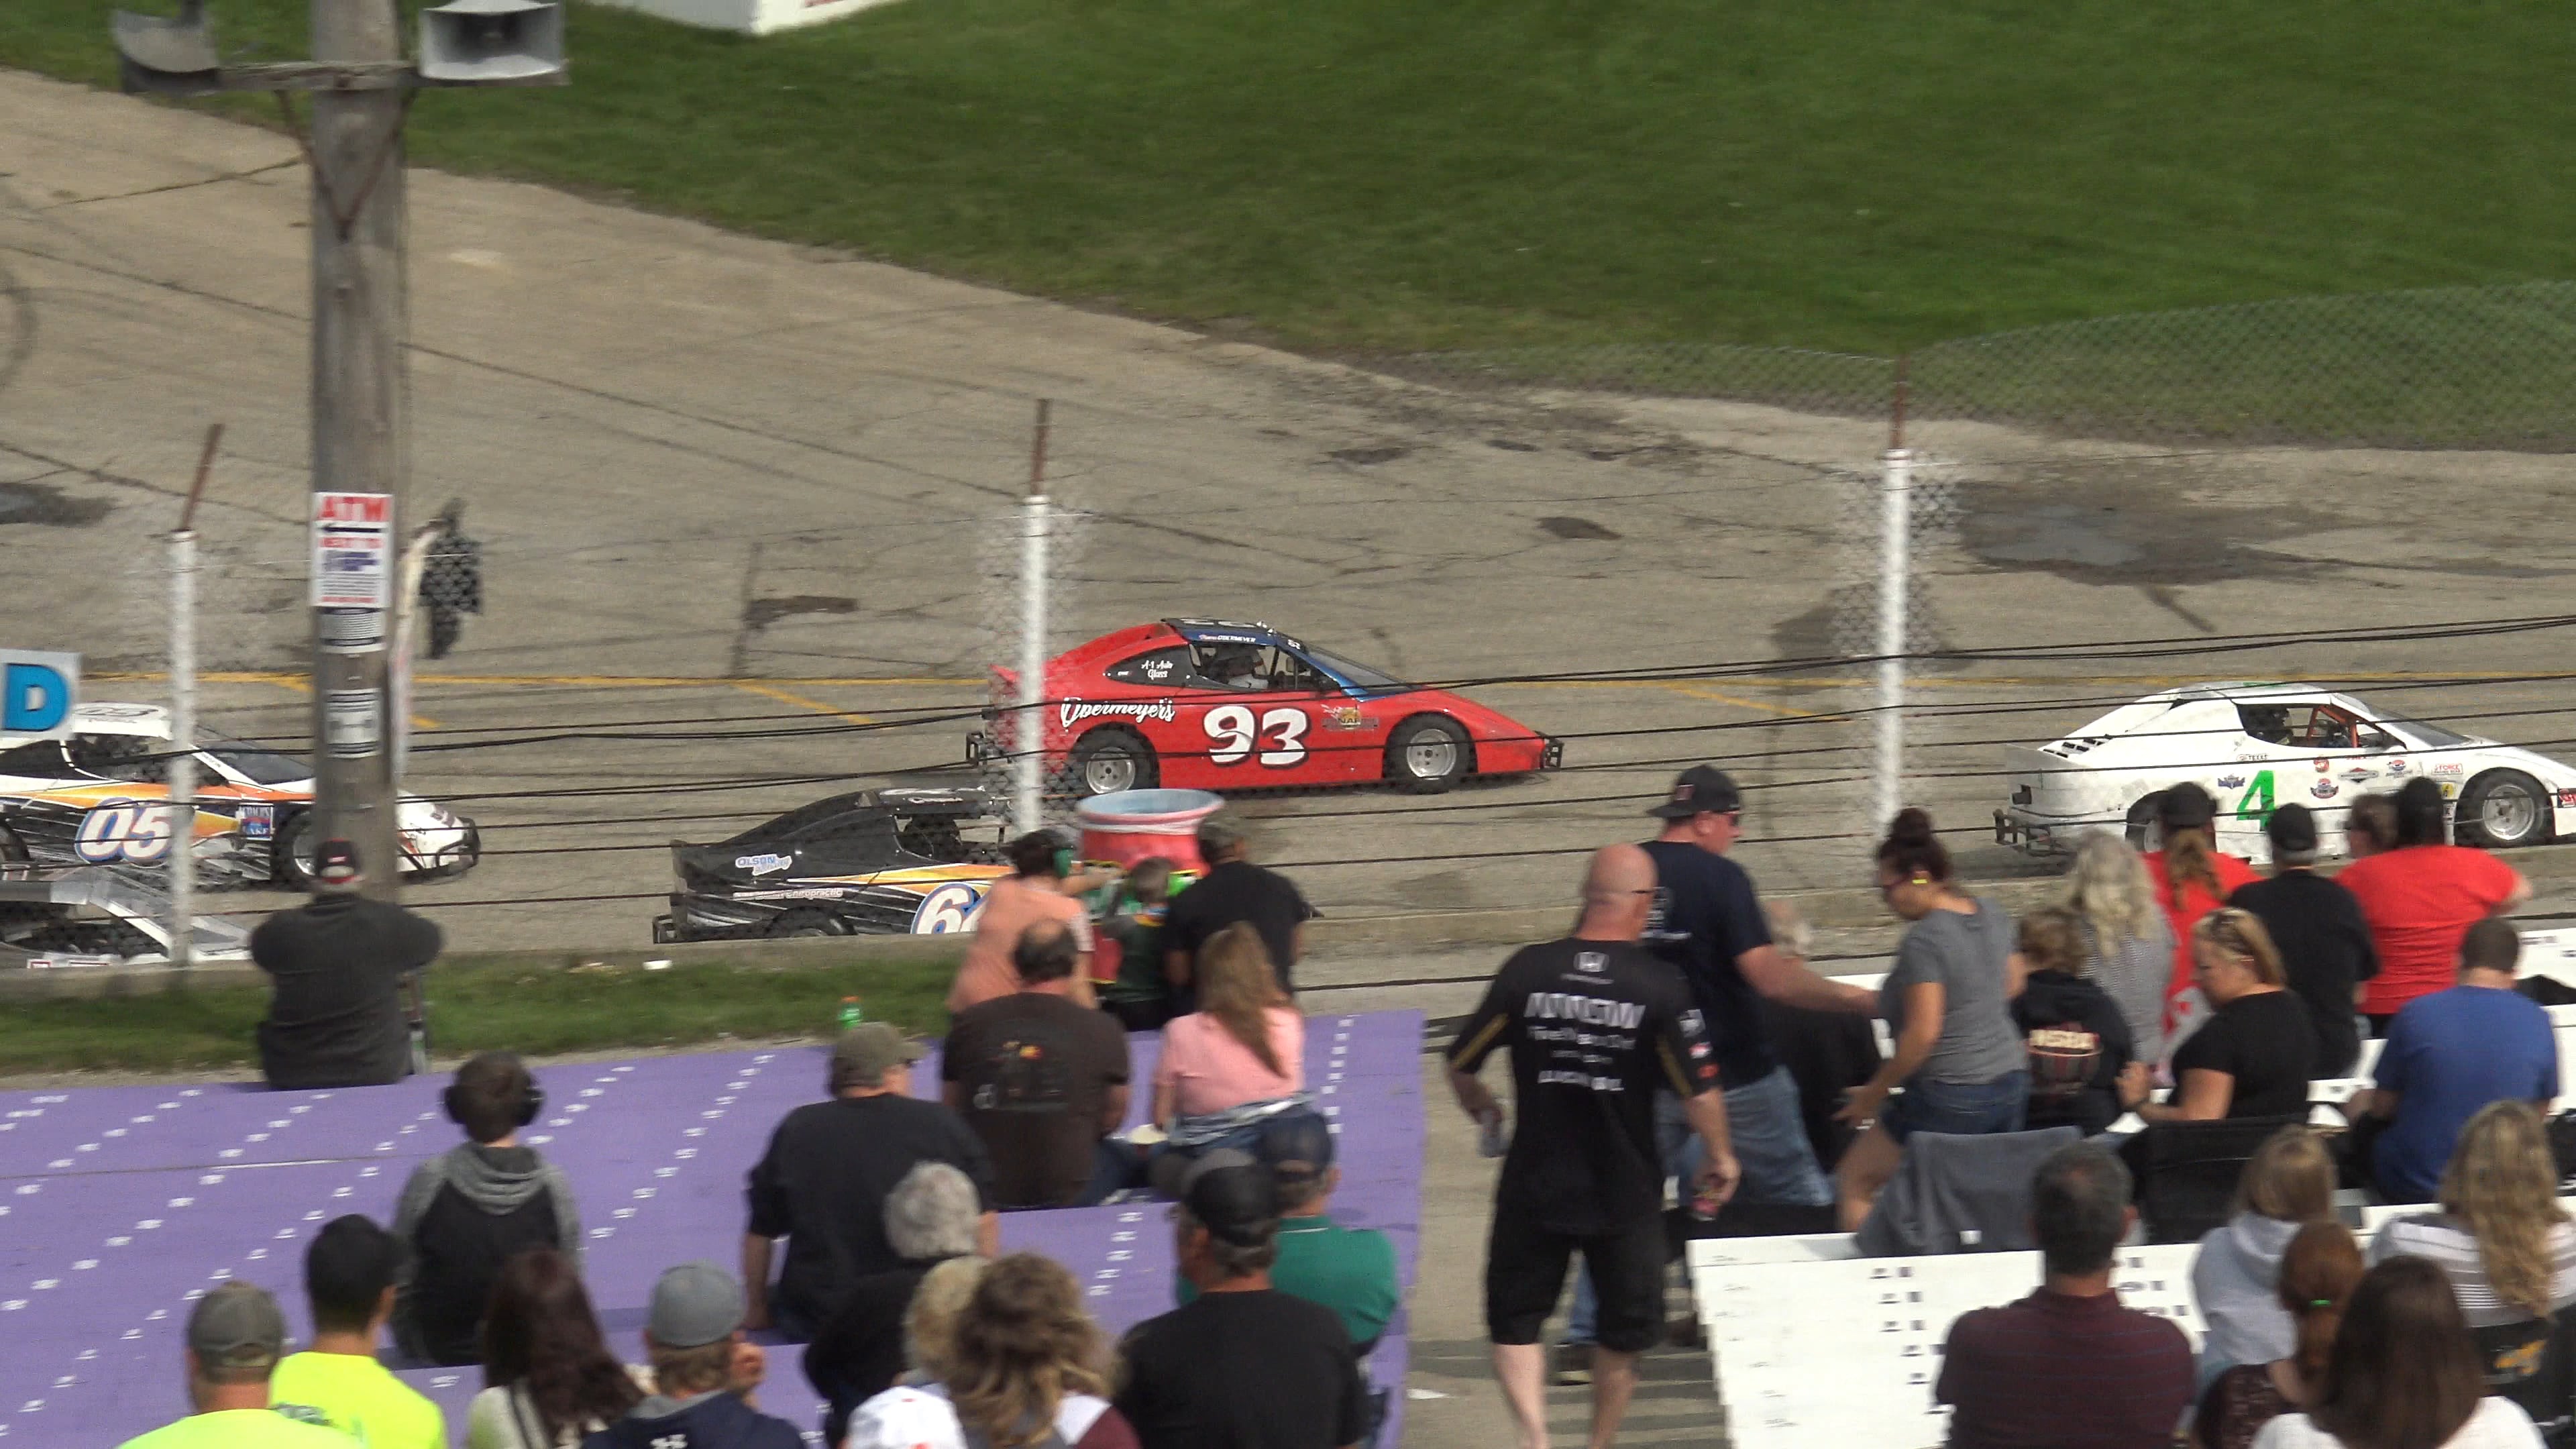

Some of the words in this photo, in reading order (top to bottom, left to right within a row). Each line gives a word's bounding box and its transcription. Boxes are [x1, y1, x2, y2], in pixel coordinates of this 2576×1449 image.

[1203, 704, 1310, 768] 93
[76, 798, 172, 860] 05
[2237, 770, 2275, 830] 4
[737, 856, 775, 866] OLSON
[911, 881, 988, 933] 6
